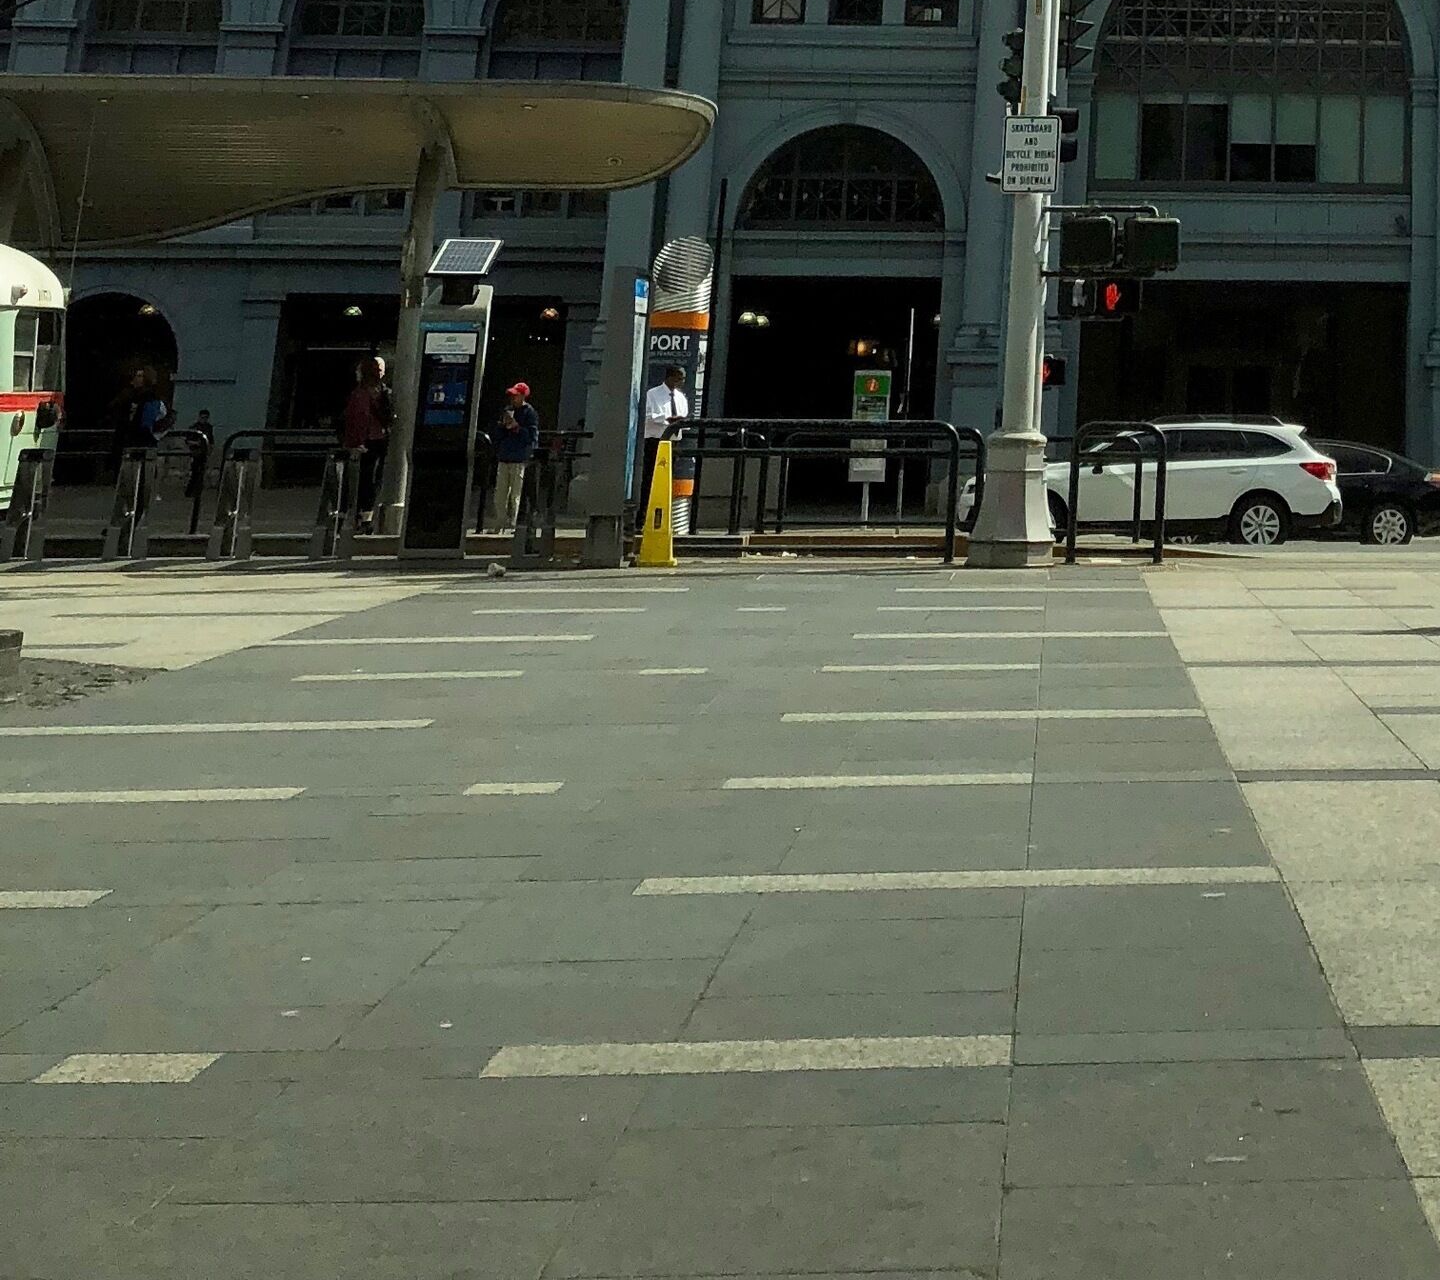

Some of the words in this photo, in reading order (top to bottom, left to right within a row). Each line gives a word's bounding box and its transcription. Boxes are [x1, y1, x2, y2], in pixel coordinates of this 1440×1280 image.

[1011, 124, 1052, 133] SKATEBOARD
[1024, 138, 1038, 146] AND
[1006, 150, 1030, 159] BICYCLE
[1011, 163, 1049, 172] PROHIBITED
[1007, 176, 1016, 185] ON
[1020, 176, 1051, 185] SIDEWALK
[650, 335, 690, 351] PORT
